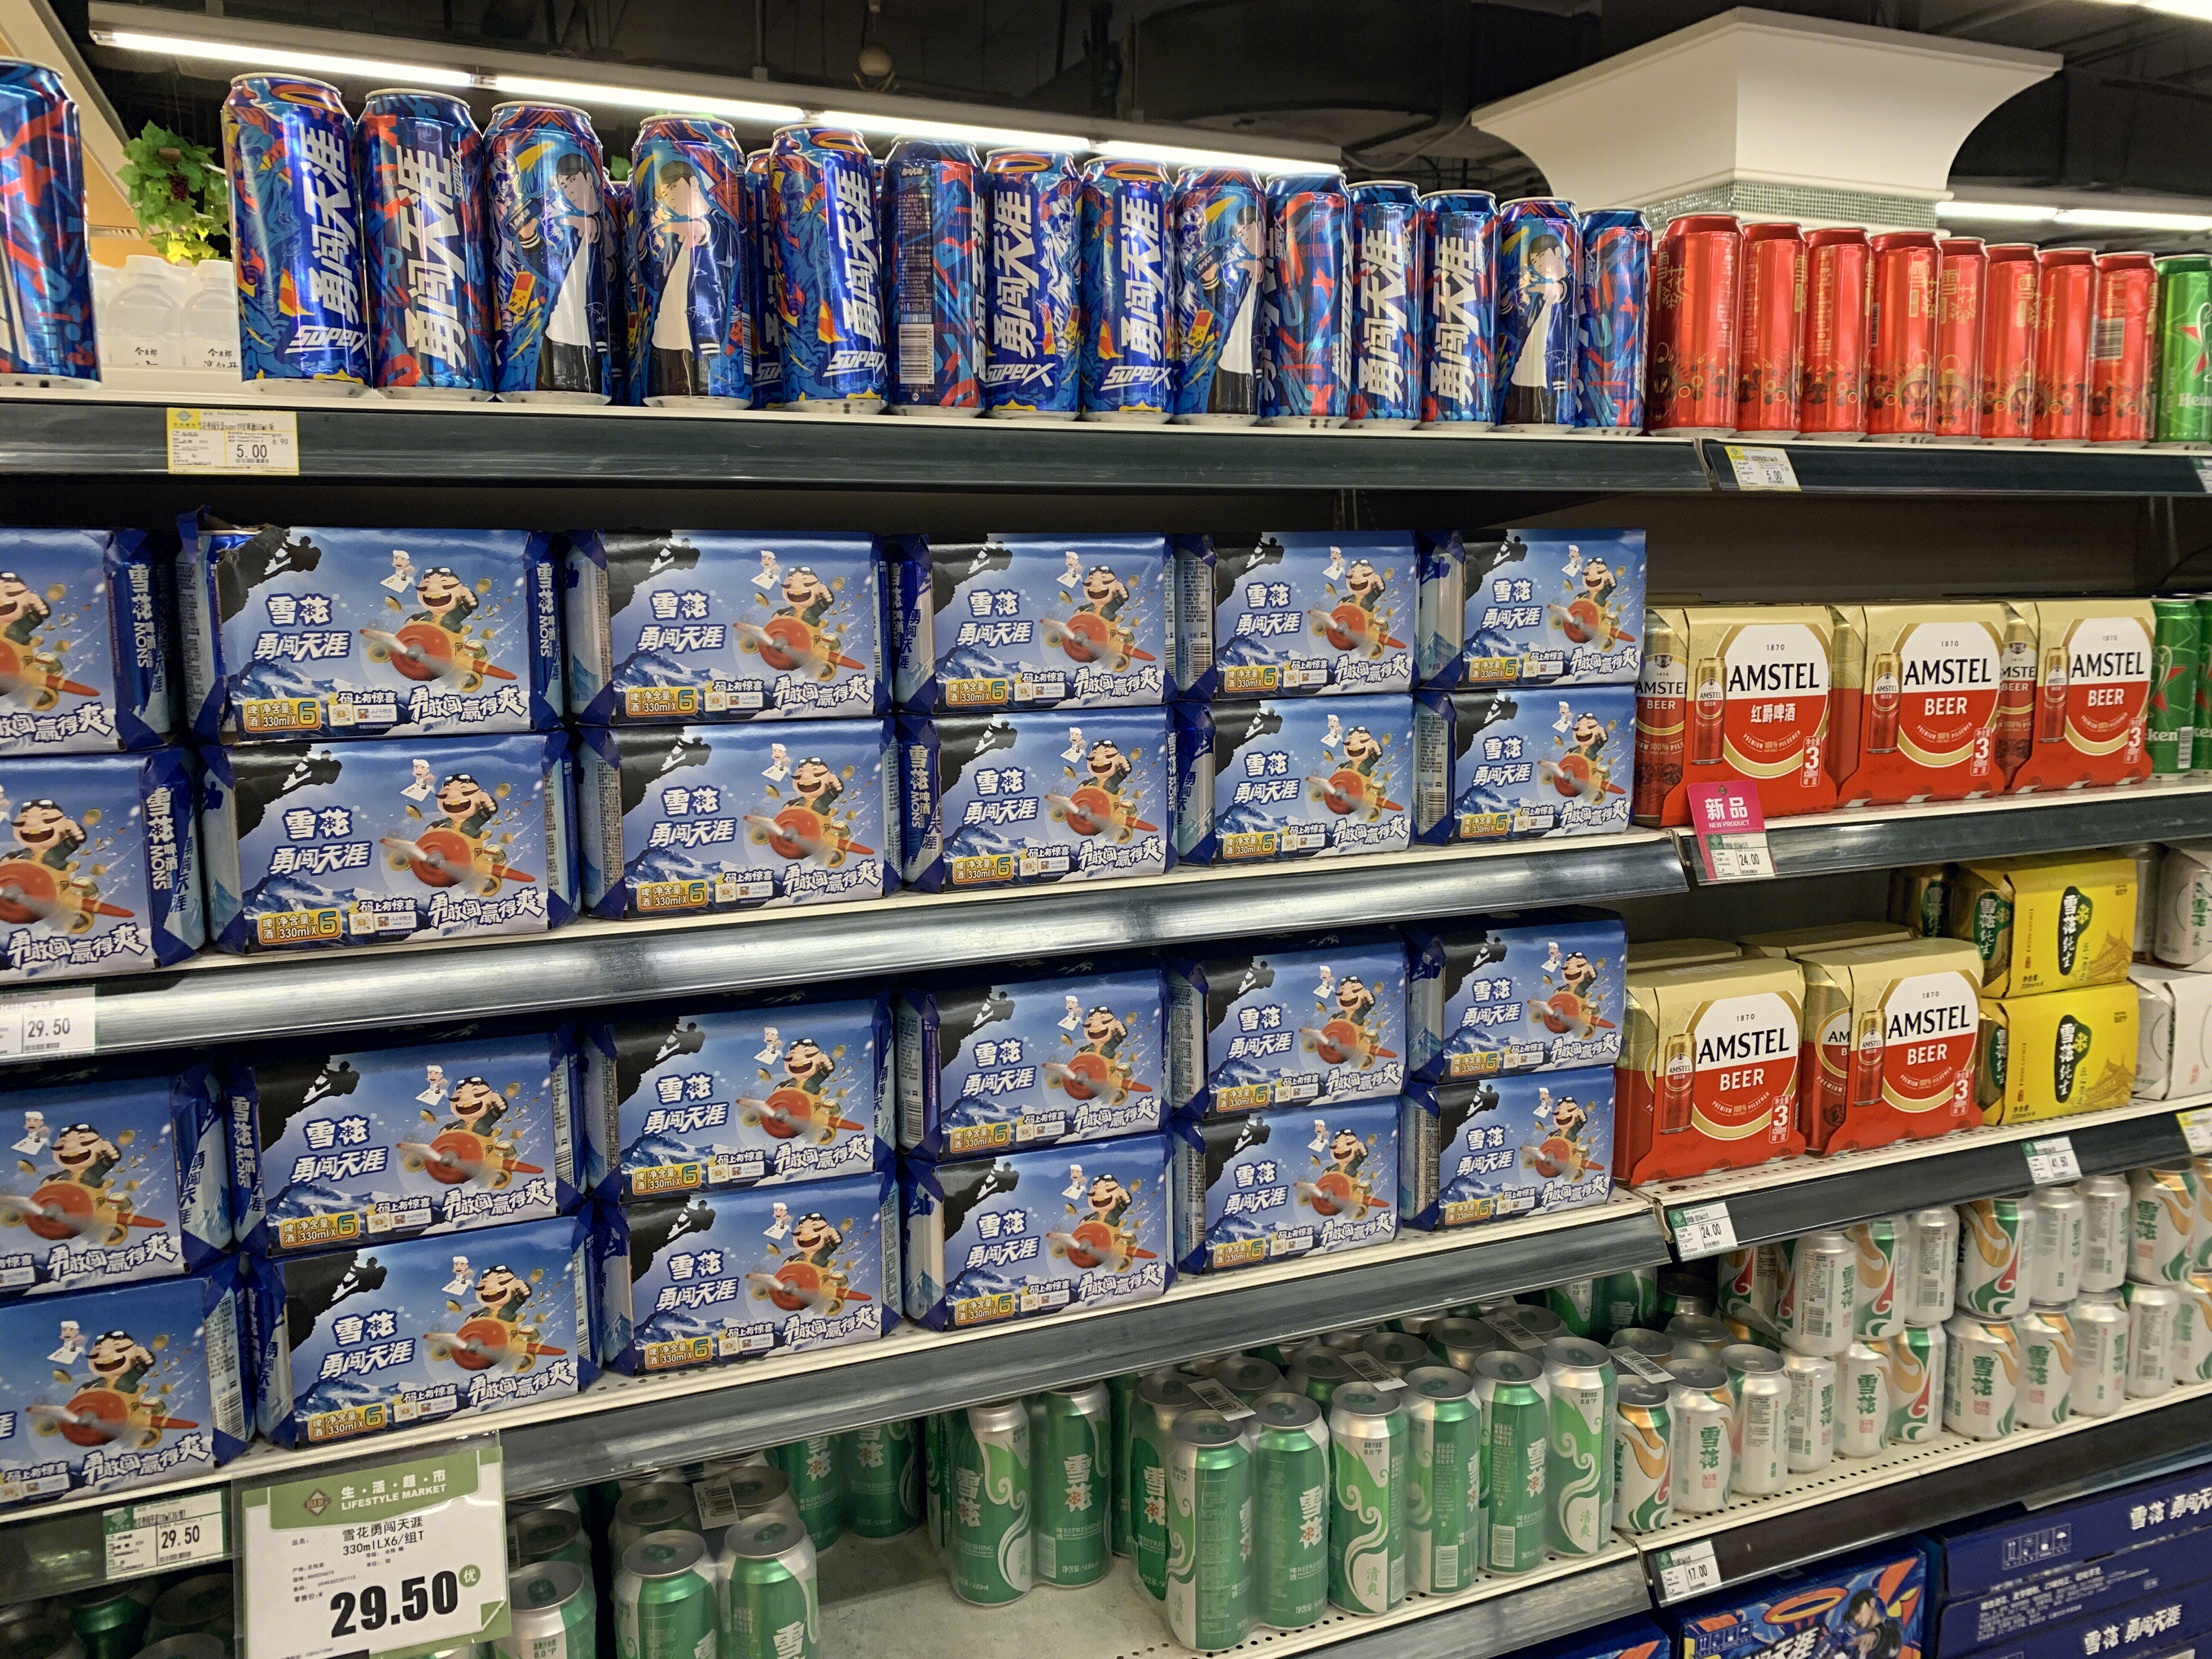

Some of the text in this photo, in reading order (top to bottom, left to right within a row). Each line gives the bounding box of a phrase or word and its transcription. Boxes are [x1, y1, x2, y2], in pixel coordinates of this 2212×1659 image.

[299, 123, 359, 325] 勇闯天涯
[397, 144, 466, 370] 勇闯天涯
[834, 169, 878, 347] 勇闯天涯
[994, 189, 1040, 360] 勇闯天涯
[1120, 187, 1164, 361] 勇闯天涯
[1358, 227, 1407, 404] 勇闯天涯
[1431, 235, 1479, 405] 勇闯天涯
[237, 445, 267, 458] 5.00
[1766, 470, 1782, 480] 5.00
[128, 563, 153, 620] 雪花
[537, 562, 554, 614] 雪花
[1248, 584, 1289, 607] 雪花
[1494, 580, 1532, 602] 雪花
[267, 596, 330, 624] 雪花
[652, 592, 707, 618] 雪花
[970, 591, 1018, 616] 雪花
[1235, 613, 1301, 636] 勇闯天涯
[1482, 607, 1541, 629] 勇闯天涯
[252, 633, 351, 661] 勇闯天涯
[638, 626, 725, 652] 勇闯天涯
[957, 622, 1032, 646] 勇闯天涯
[1728, 663, 1820, 692] AMSTEL
[1904, 658, 1991, 685] AMSTEL
[2071, 652, 2145, 678] AMSTEL
[1646, 701, 1675, 709] BEER
[1925, 696, 1968, 716] BEER
[2088, 688, 2124, 707] BEER
[1751, 703, 1796, 723] 红爵啤酒
[1485, 737, 1522, 759] 雪花
[1805, 747, 1819, 769] 3
[1975, 738, 1989, 759] 3
[909, 745, 929, 791] 雪花
[1246, 752, 1287, 776] 雪花
[1473, 764, 1532, 786] 勇闯天涯
[976, 769, 1023, 794] 雪花
[1234, 780, 1299, 804] 勇闯天涯
[663, 787, 718, 815] 雪花
[964, 798, 1037, 825] 勇闯天涯
[1705, 797, 1748, 820] 新品
[146, 787, 174, 844] 雪花
[285, 808, 350, 838] 雪花
[650, 819, 735, 848] 勇闯天涯
[271, 843, 370, 874] 勇闯天涯
[1739, 853, 1759, 866] 24.00
[2063, 894, 2078, 968] 雪花纯生
[1474, 978, 1511, 1001] 雪花
[28, 1018, 70, 1037] 29.50
[1240, 1006, 1280, 1031] 雪花
[1462, 1003, 1521, 1027] 勇闯天涯
[1887, 1005, 1970, 1039] AMSTEL
[975, 1039, 1021, 1066] 雪花
[1228, 1032, 1293, 1059] 勇闯天涯
[1697, 1028, 1790, 1064] AMSTEL
[1907, 1043, 1948, 1065] BEER
[2058, 1023, 2075, 1097] 雪花纯生
[658, 1074, 711, 1102] 雪花
[962, 1066, 1035, 1097] 勇闯天涯
[1720, 1068, 1764, 1091] BEER
[232, 1096, 253, 1146] 雪花
[644, 1103, 728, 1135] 勇闯天涯
[1773, 1105, 1788, 1126] 3
[306, 1116, 368, 1148] 雪花
[1468, 1126, 1504, 1150] 雪花
[292, 1147, 387, 1183] 勇闯天涯
[1235, 1161, 1276, 1187] 雪花
[1457, 1150, 1514, 1176] 勇闯天涯
[1224, 1186, 1288, 1215] 勇闯天涯
[978, 1210, 1025, 1238] 雪花
[1701, 1223, 1721, 1238] 24.00
[669, 1250, 721, 1279] 雪花
[966, 1237, 1039, 1268] 勇闯天涯
[657, 1278, 738, 1311] 勇闯天涯
[334, 1310, 395, 1344] 雪花
[320, 1339, 414, 1379] 勇闯天涯
[1971, 1355, 1995, 1397] 雪花
[1857, 1374, 1878, 1414] 雪花
[1700, 1426, 1721, 1469] 雪花
[342, 1484, 447, 1510] LIFESTYLE MARKET
[1064, 1454, 1093, 1513] 雪花
[343, 1516, 423, 1542] 雪花勇闯天涯
[1299, 1485, 1323, 1550] 雪花
[2130, 1501, 2165, 1530] 雪花
[161, 1526, 200, 1549] 29.50
[464, 1570, 476, 1583] 优
[1689, 1564, 1707, 1581] 17.00
[330, 1571, 458, 1638] 29.50
[2085, 1605, 2182, 1655] 雪花 勇闯天涯
